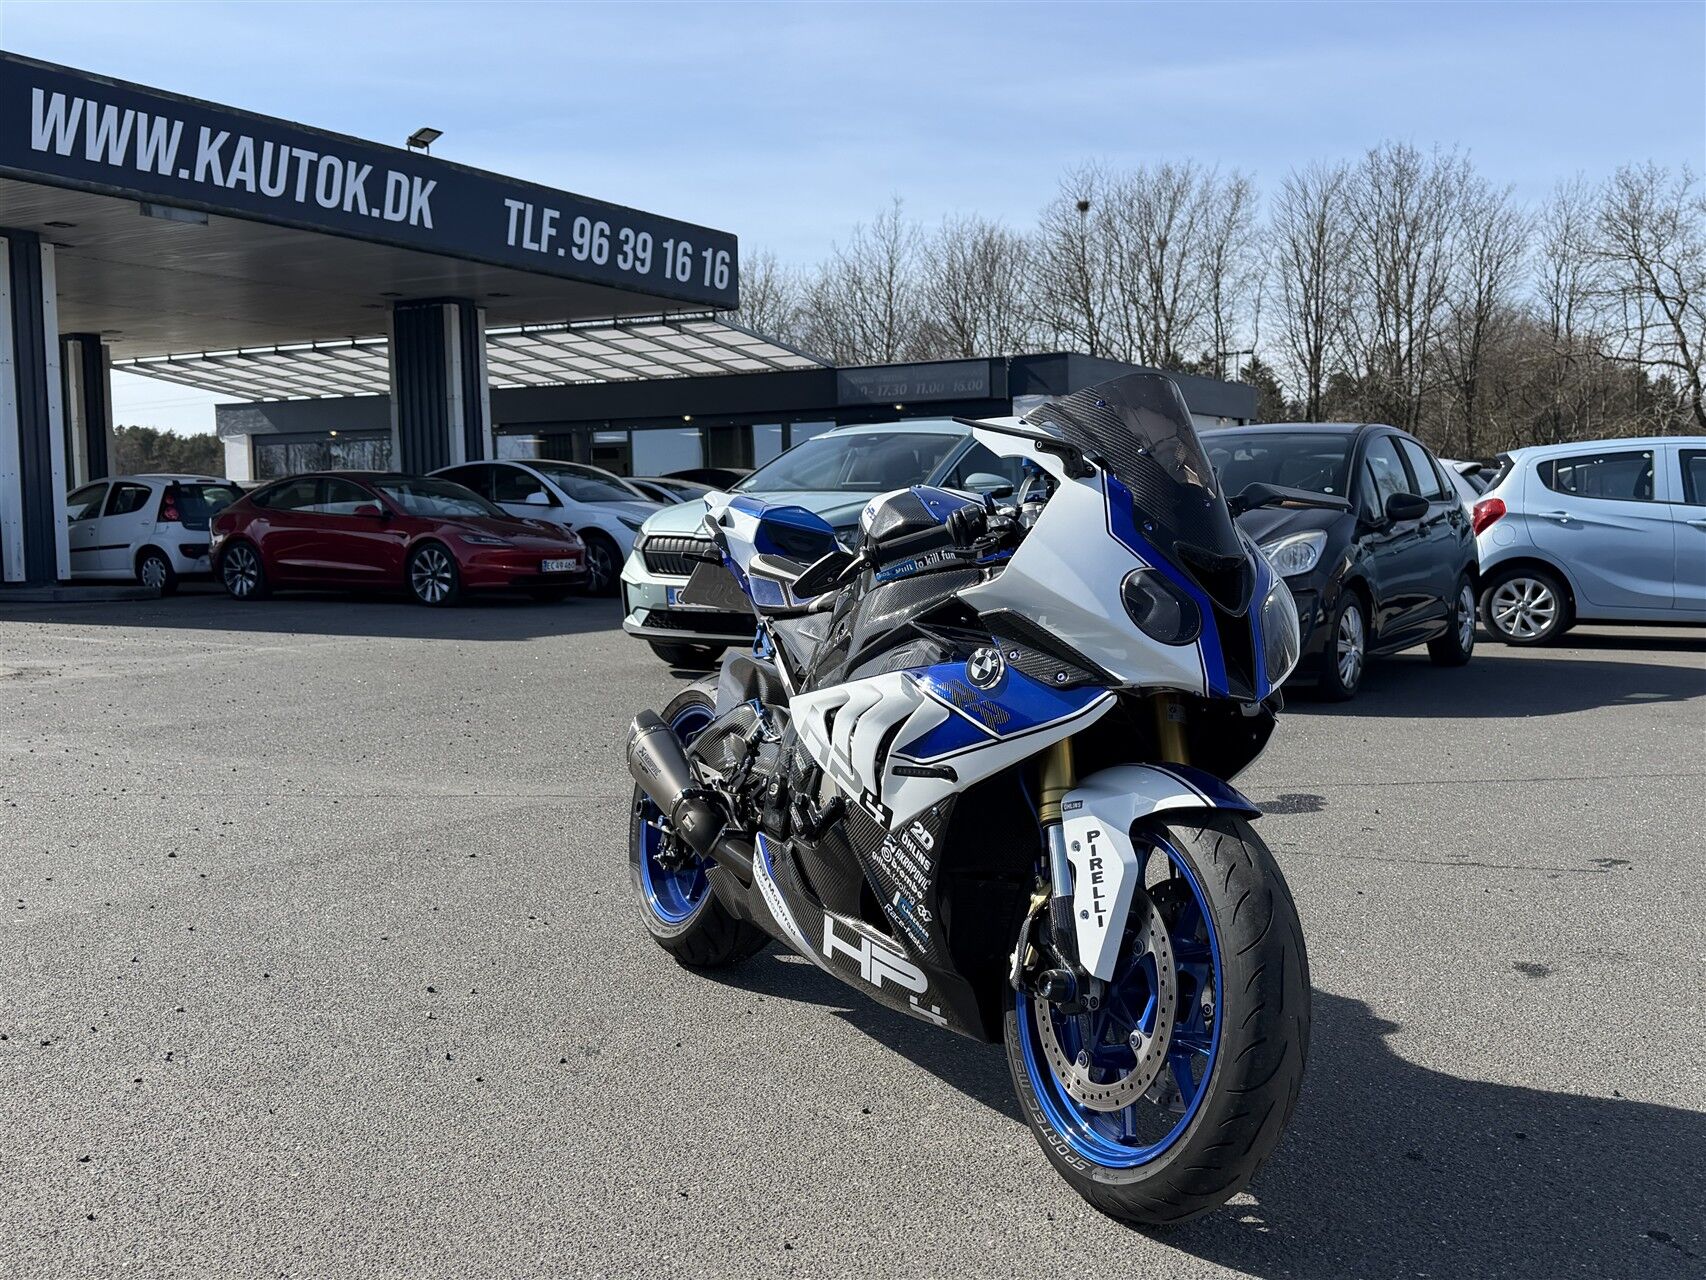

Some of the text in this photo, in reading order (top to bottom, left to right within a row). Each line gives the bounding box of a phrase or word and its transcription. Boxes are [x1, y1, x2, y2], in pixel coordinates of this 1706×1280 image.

[31, 87, 437, 230] WWW.KAUTOK.DK
[504, 198, 731, 290] TLF. 96 39 16 16
[925, 552, 940, 566] kill
[940, 550, 957, 561] fun
[910, 821, 935, 851] 2D
[1086, 830, 1106, 928] PIRELLI
[1025, 1098, 1092, 1172] SPORTEC
